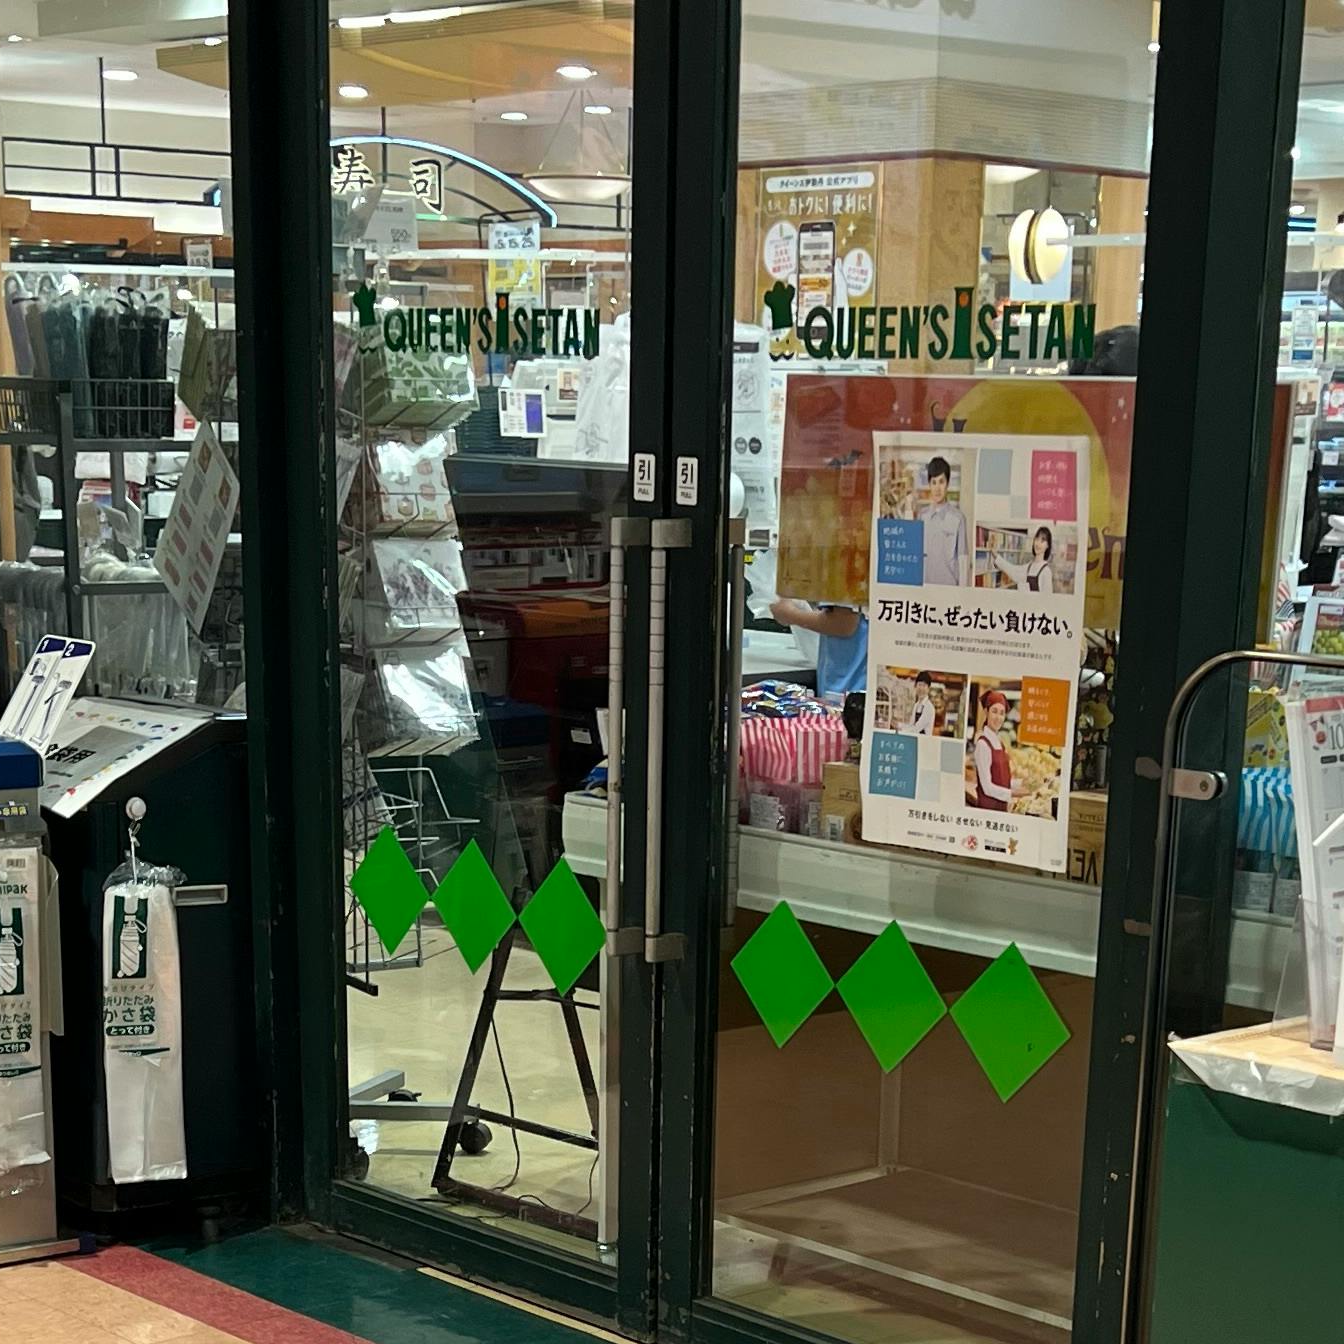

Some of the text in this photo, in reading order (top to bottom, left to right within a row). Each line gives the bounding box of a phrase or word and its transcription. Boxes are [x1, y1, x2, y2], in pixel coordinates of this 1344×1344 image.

[383, 307, 492, 355] QUEEN'S
[803, 304, 949, 360] QUEEN'S
[638, 459, 651, 481] 引
[680, 463, 694, 484] 引
[878, 599, 1073, 639] 万引きに、ぜったい負けない。
[64, 644, 75, 657] 2
[104, 994, 154, 1006] 折りたたみ
[104, 1006, 155, 1023] かさ袋
